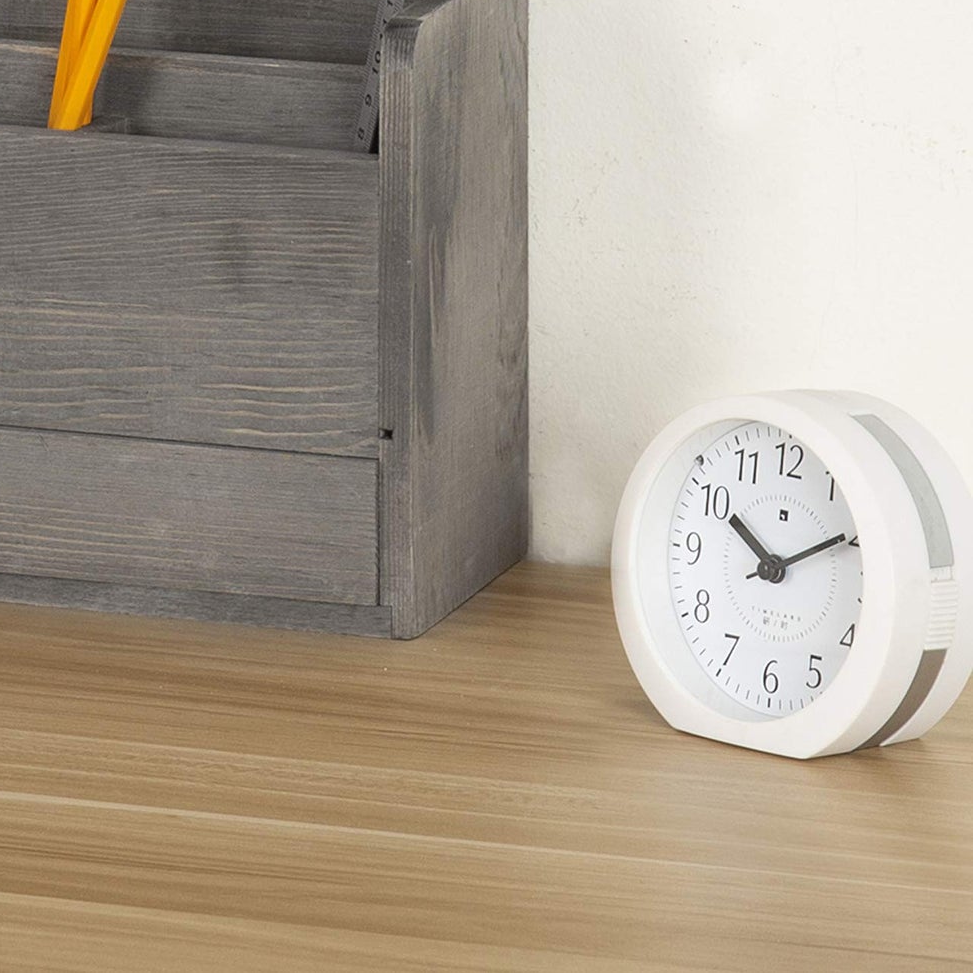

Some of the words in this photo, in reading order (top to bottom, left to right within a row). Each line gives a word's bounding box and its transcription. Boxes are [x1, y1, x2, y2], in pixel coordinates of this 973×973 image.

[734, 448, 760, 485] 11
[775, 442, 805, 480] 12
[700, 483, 730, 520] 10
[685, 531, 702, 565] 9
[693, 589, 710, 623] 8
[724, 633, 740, 666] 7
[762, 659, 779, 694] 6
[805, 654, 823, 689] 5
